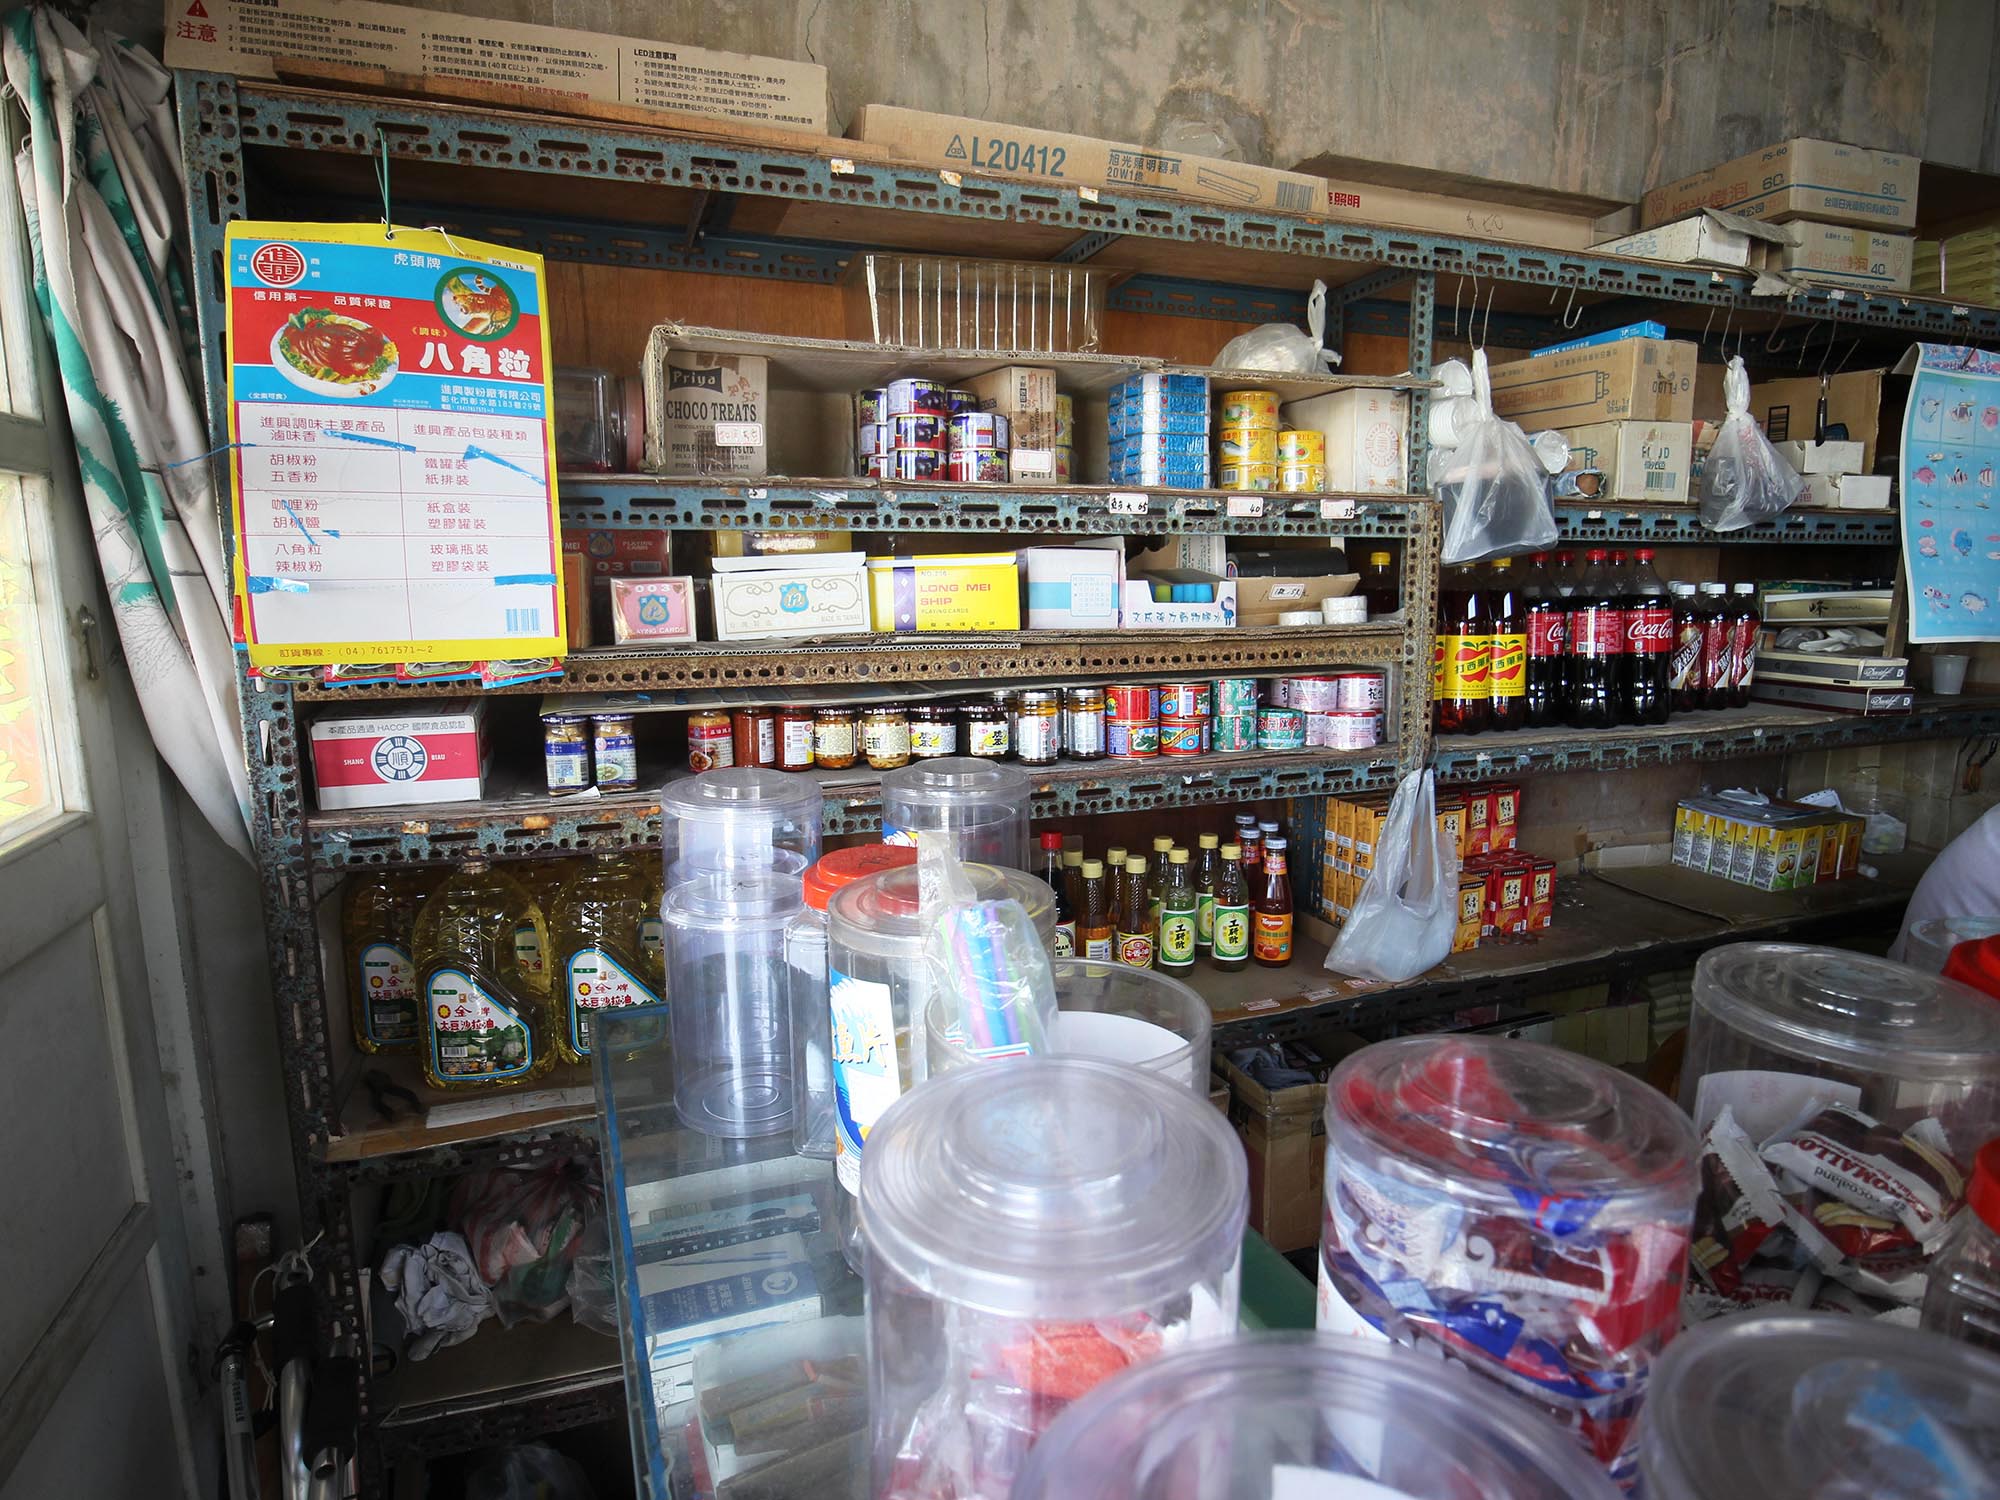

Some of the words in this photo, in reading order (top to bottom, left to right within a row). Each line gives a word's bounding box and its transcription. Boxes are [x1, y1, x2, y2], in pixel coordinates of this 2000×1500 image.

[176, 21, 217, 43] 注意
[971, 138, 1066, 177] L20412
[1109, 152, 1181, 176] 旭光照明器具
[393, 252, 442, 270] 虎頭牌
[1871, 263, 1887, 275] 40
[253, 291, 312, 303] 信用第一
[334, 295, 392, 310] 品質保證
[419, 341, 532, 380] 八角粒
[672, 371, 717, 387] Priya
[666, 400, 708, 420] CHOCO
[711, 402, 757, 422] TREATS
[260, 416, 386, 433] 進興調味主要產品
[271, 429, 316, 443] 滷味香
[413, 424, 528, 441] 進興產品包裝種類
[672, 444, 692, 452] PRIYA
[270, 453, 317, 467] 胡椒粉
[424, 457, 469, 470] 鐵罐裝
[271, 471, 318, 483] 五香粉
[425, 474, 470, 486] 紙排裝
[427, 502, 471, 514] 紙盒裝
[272, 516, 320, 529] 胡椒鹽
[428, 518, 487, 530] 塑膠罐裝
[274, 543, 323, 556] 八角粒
[430, 543, 489, 556] 玻璃瓶裝
[276, 560, 323, 573] 辣椒粉
[431, 560, 490, 573] 塑膠袋裝
[920, 584, 958, 592] LONG
[966, 583, 991, 591] MEI
[920, 597, 952, 605] SHIP
[659, 627, 684, 635] CARDS
[1627, 618, 1673, 641] Coca-Co
[328, 725, 376, 735] 本產品通過
[377, 723, 409, 732] HACCP
[343, 758, 365, 766] SHANG
[392, 750, 409, 766] 順
[374, 989, 416, 1001] 大豆沙拉
[580, 995, 632, 1008] 大豆沙拉油
[440, 1018, 494, 1032] 大豆沙拉油
